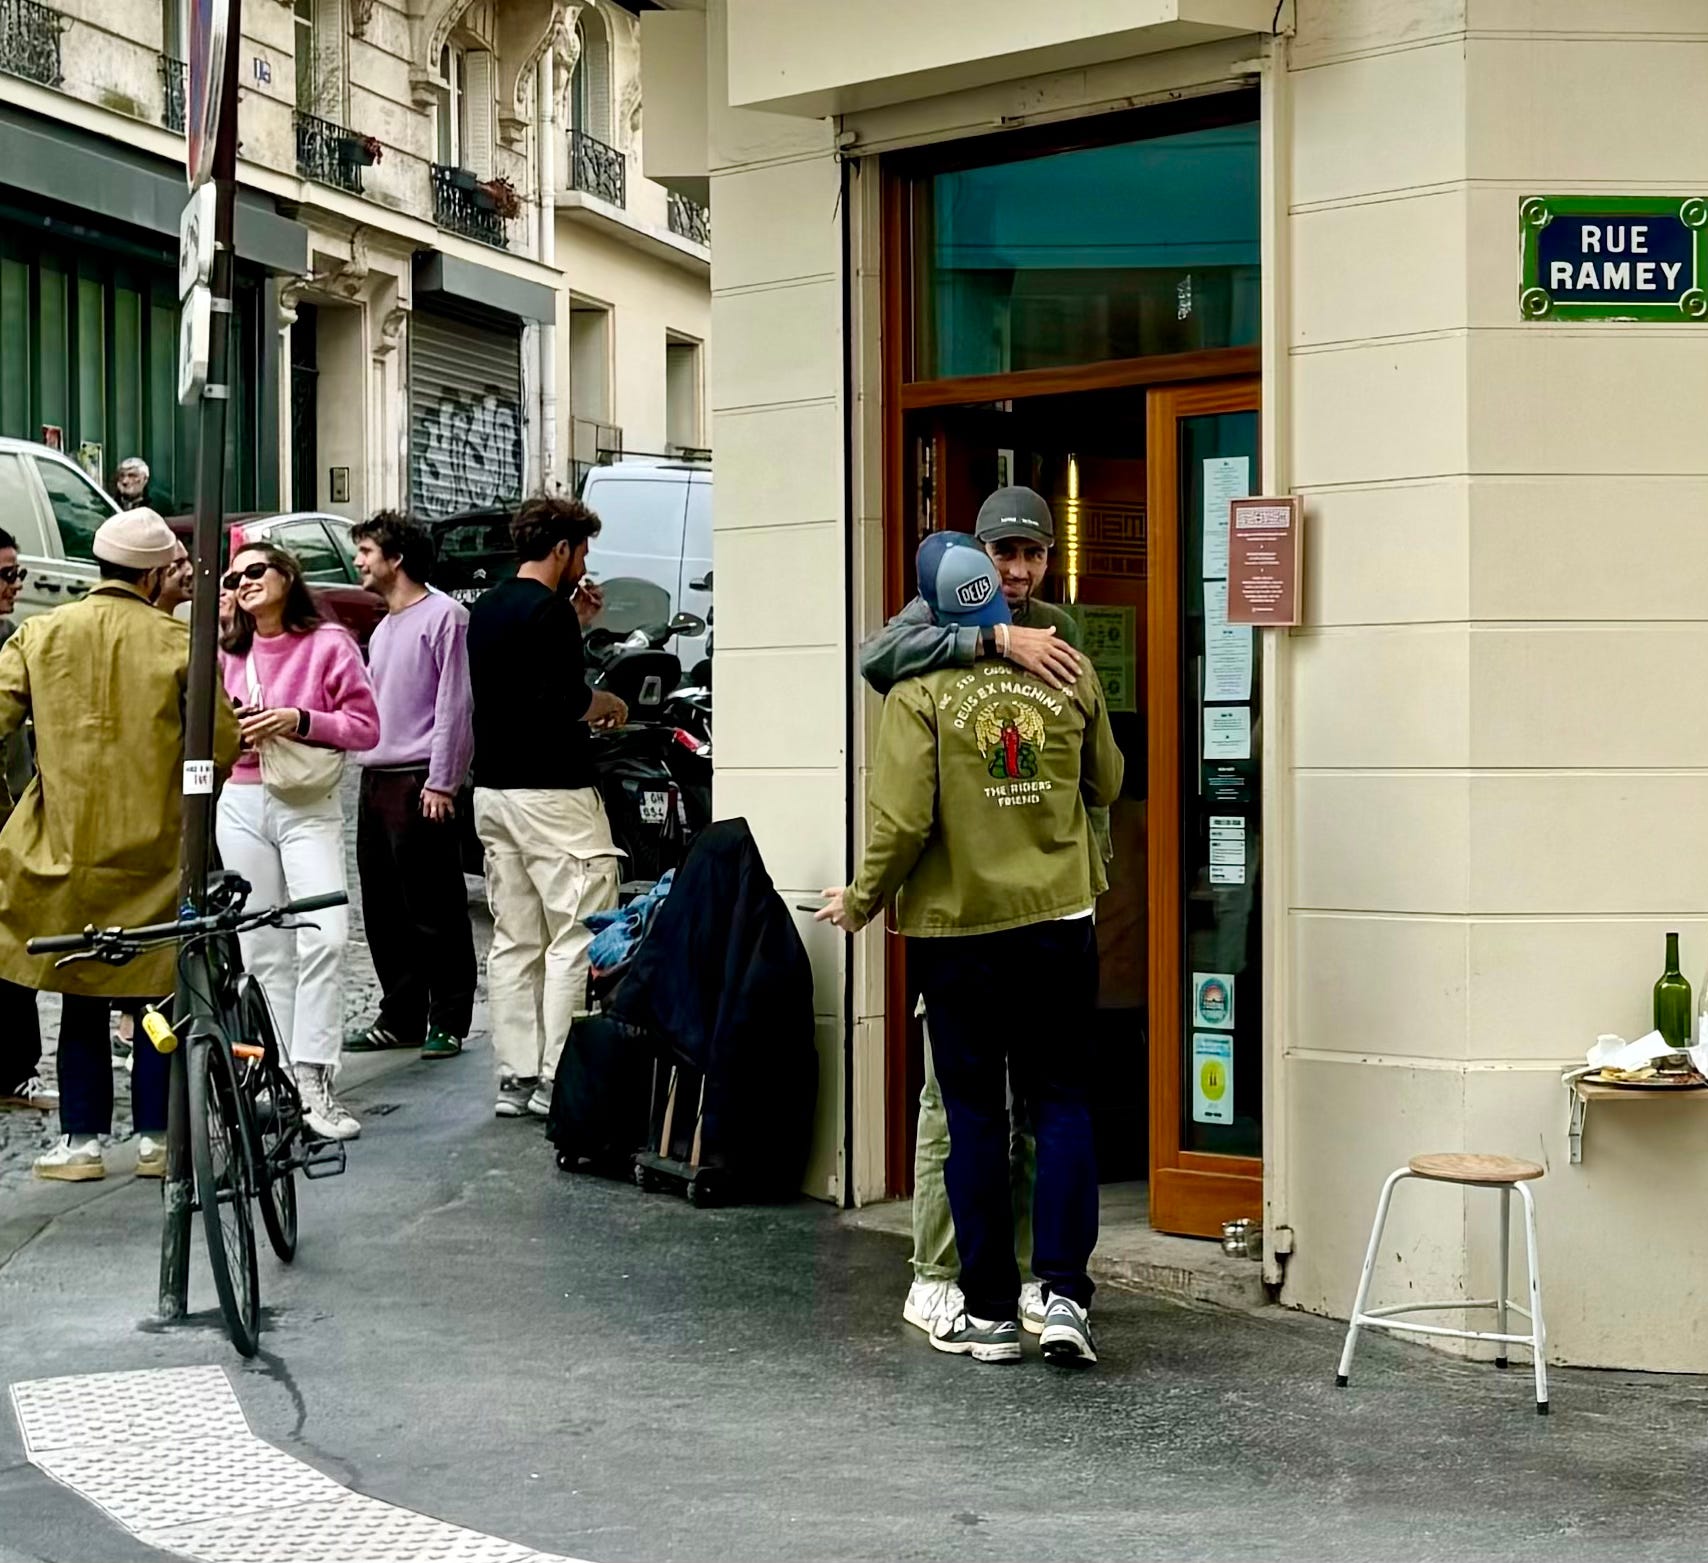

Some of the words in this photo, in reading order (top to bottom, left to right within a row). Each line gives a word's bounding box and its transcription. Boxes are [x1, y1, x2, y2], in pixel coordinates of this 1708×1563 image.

[1581, 225, 1649, 254] RUE
[1550, 261, 1683, 291] RAMEY
[961, 578, 990, 602] DEUS
[954, 695, 979, 729] DEUS
[1000, 681, 1063, 717] MACHINA
[984, 785, 1007, 798] THE
